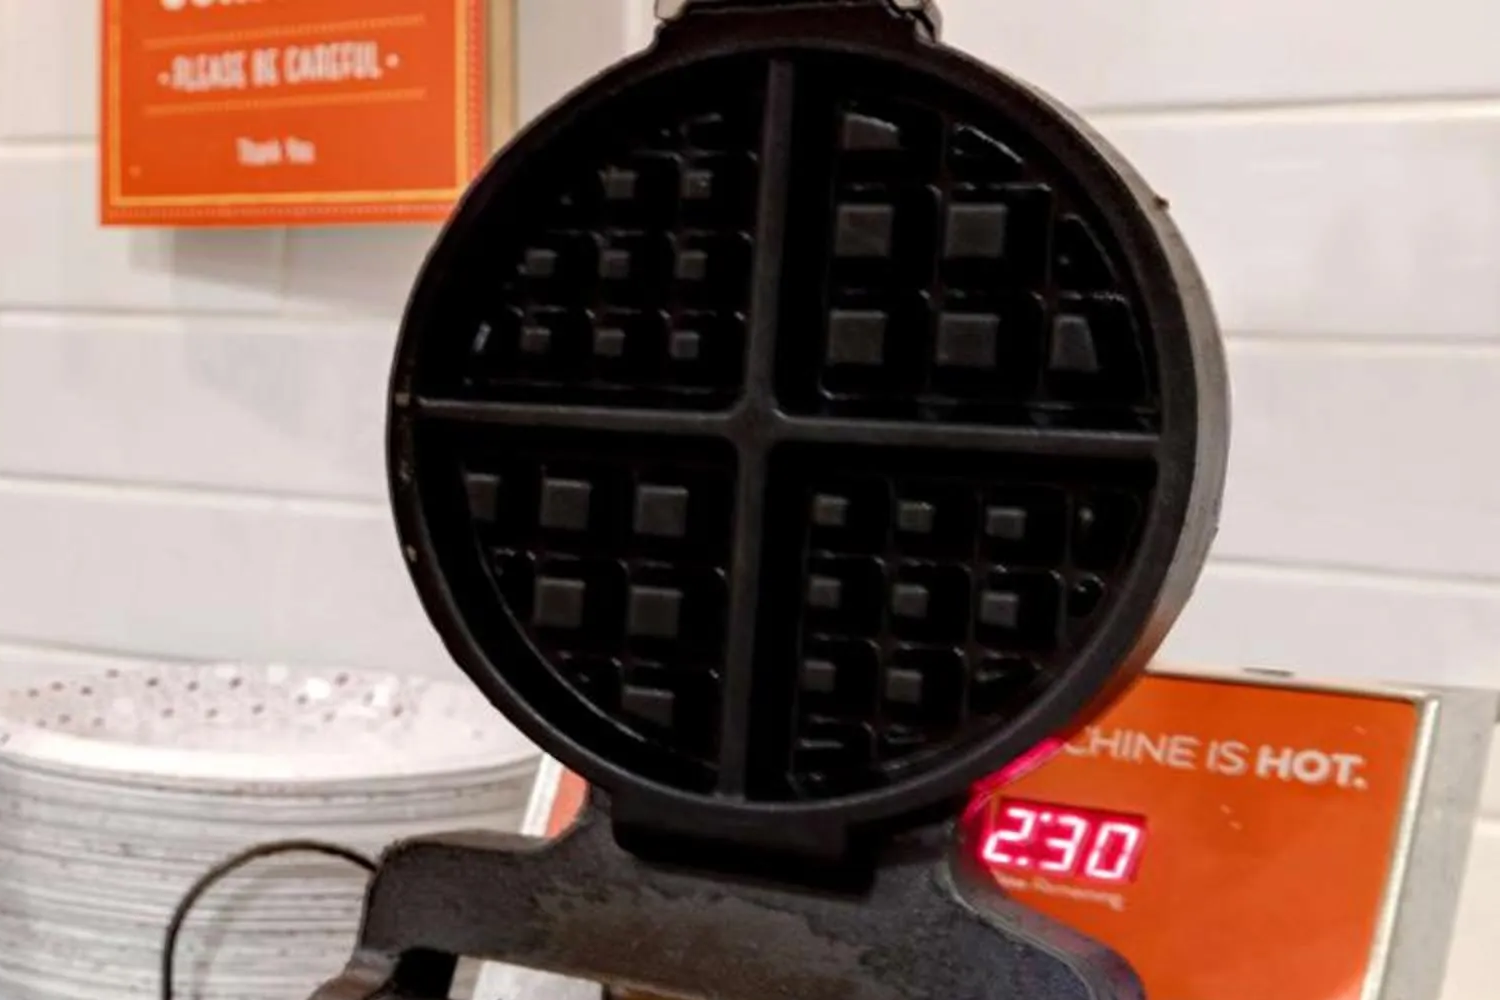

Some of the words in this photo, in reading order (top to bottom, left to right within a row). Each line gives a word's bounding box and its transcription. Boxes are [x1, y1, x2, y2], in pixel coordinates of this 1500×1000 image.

[171, 50, 248, 92] PLEASE
[252, 47, 280, 88] BE
[284, 40, 384, 84] CAREFUL
[236, 135, 282, 166] Thank
[284, 135, 316, 165] You
[1205, 739, 1250, 776] IS
[1255, 745, 1369, 790] HOT.
[982, 806, 1142, 880] 2:30
